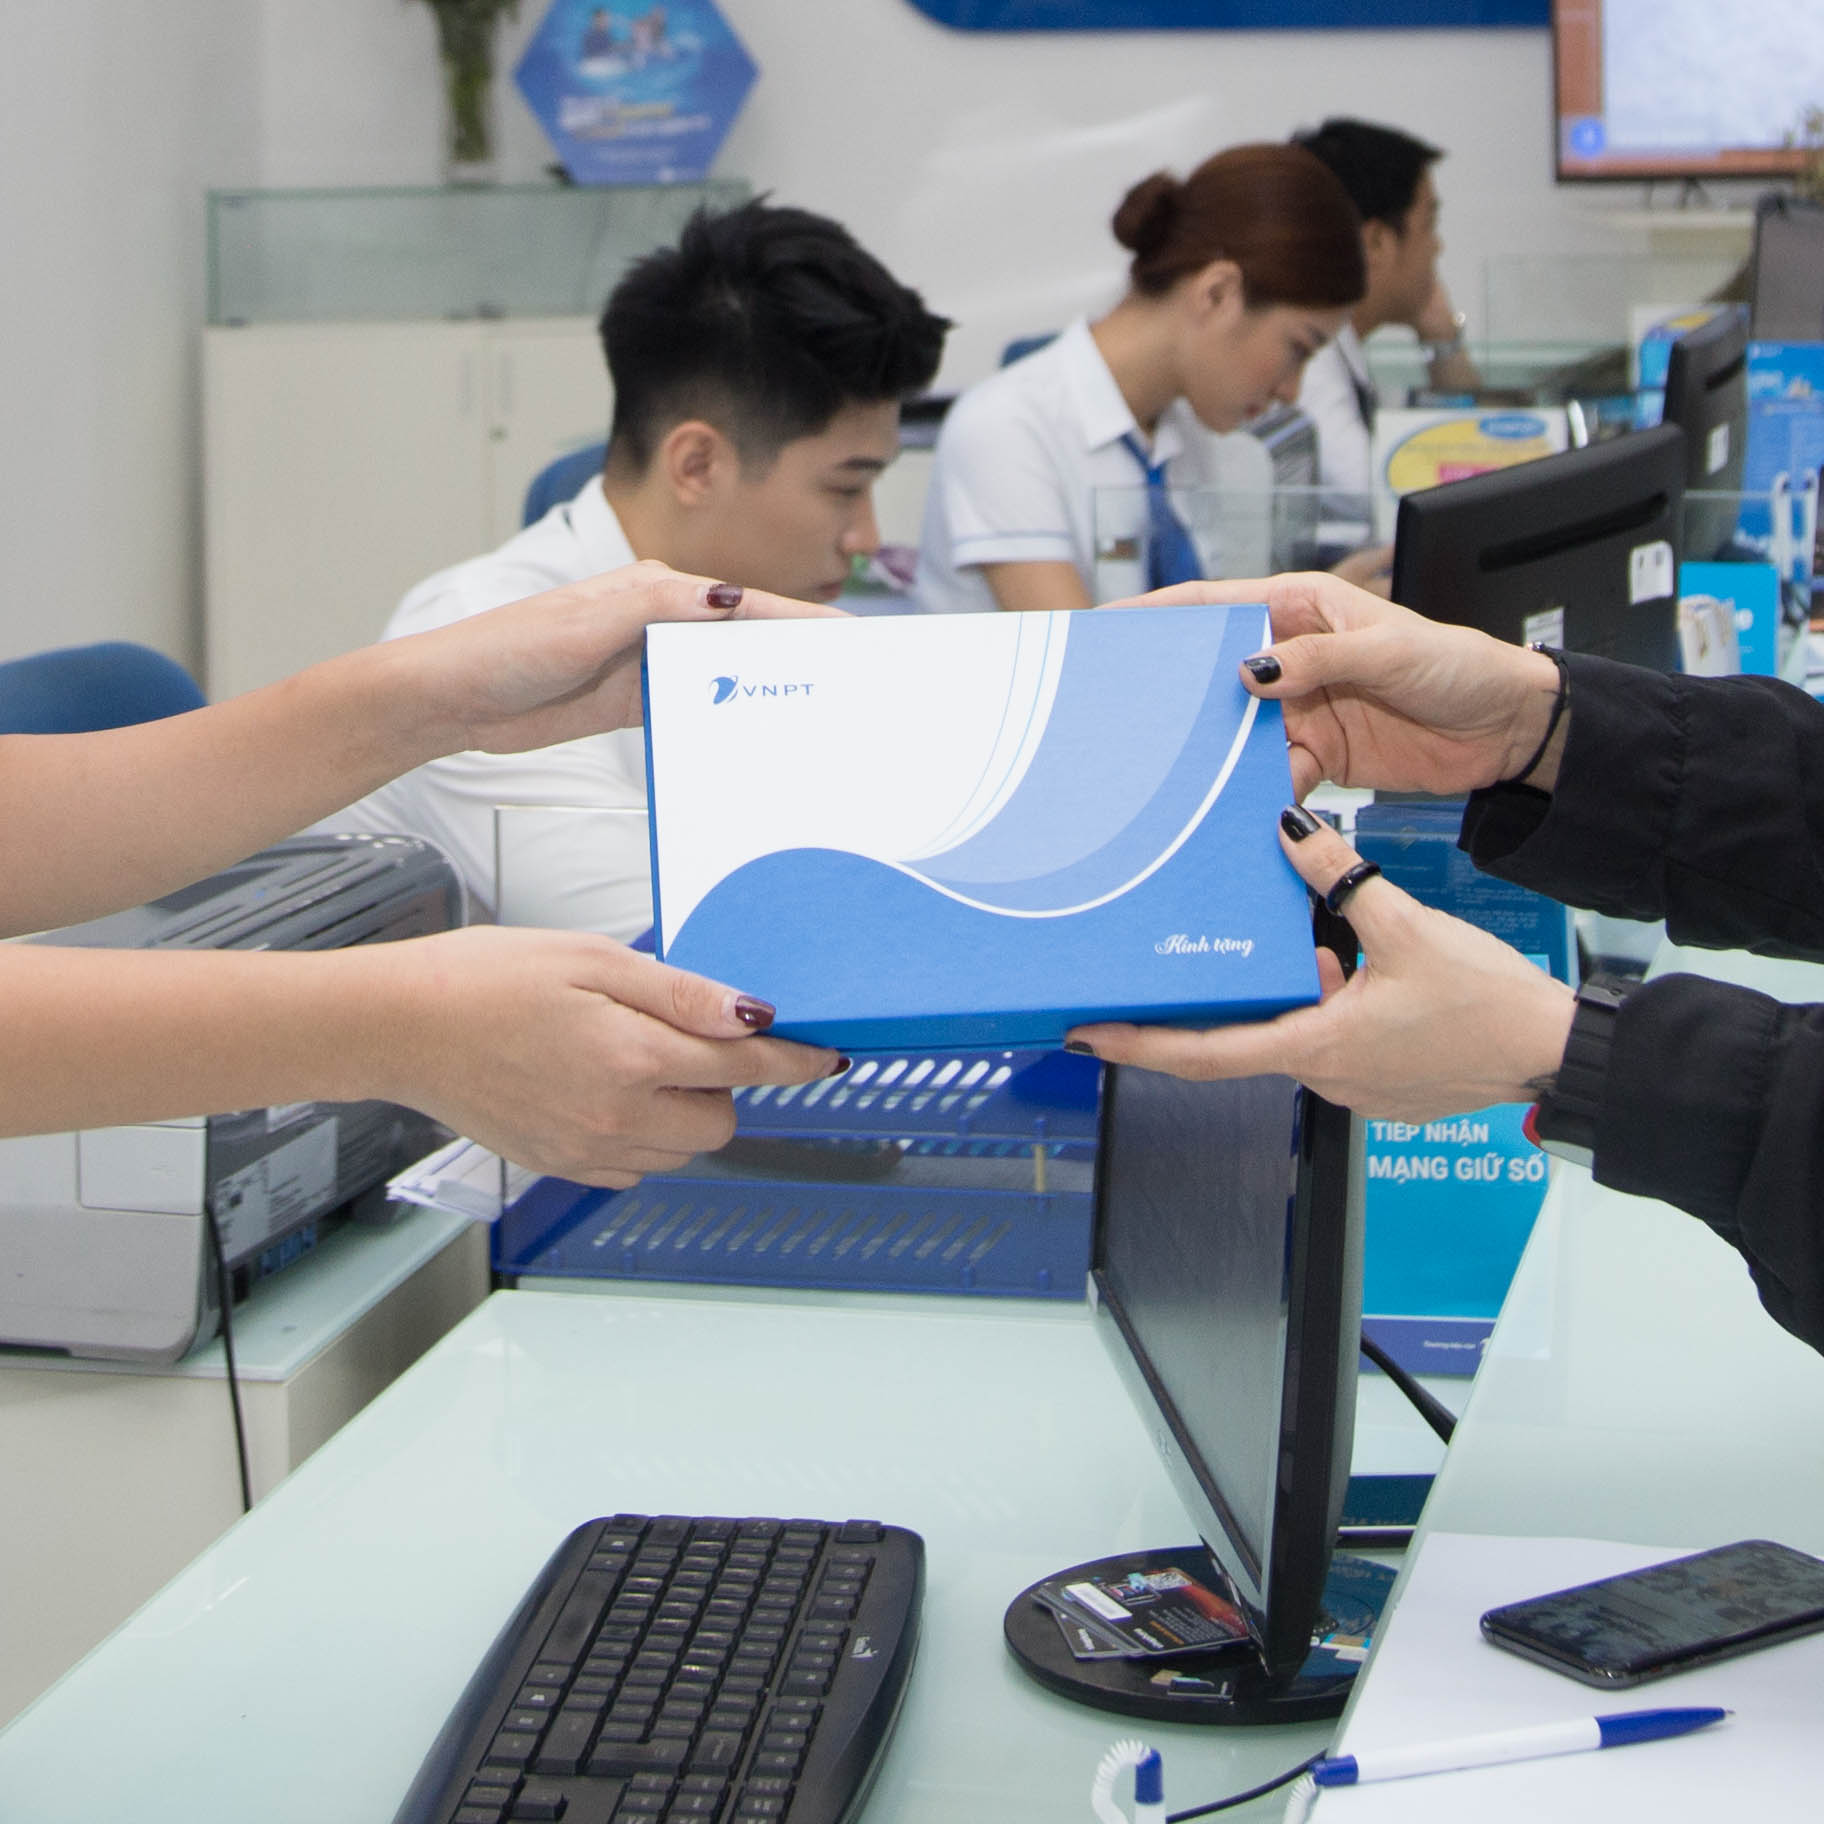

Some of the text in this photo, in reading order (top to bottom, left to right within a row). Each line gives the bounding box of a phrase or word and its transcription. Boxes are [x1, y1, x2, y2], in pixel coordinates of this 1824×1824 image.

[742, 683, 815, 697] VNPT
[1424, 1118, 1489, 1147] NHẬN
[1368, 1150, 1545, 1184] MẠNG GIỮ SỐ
